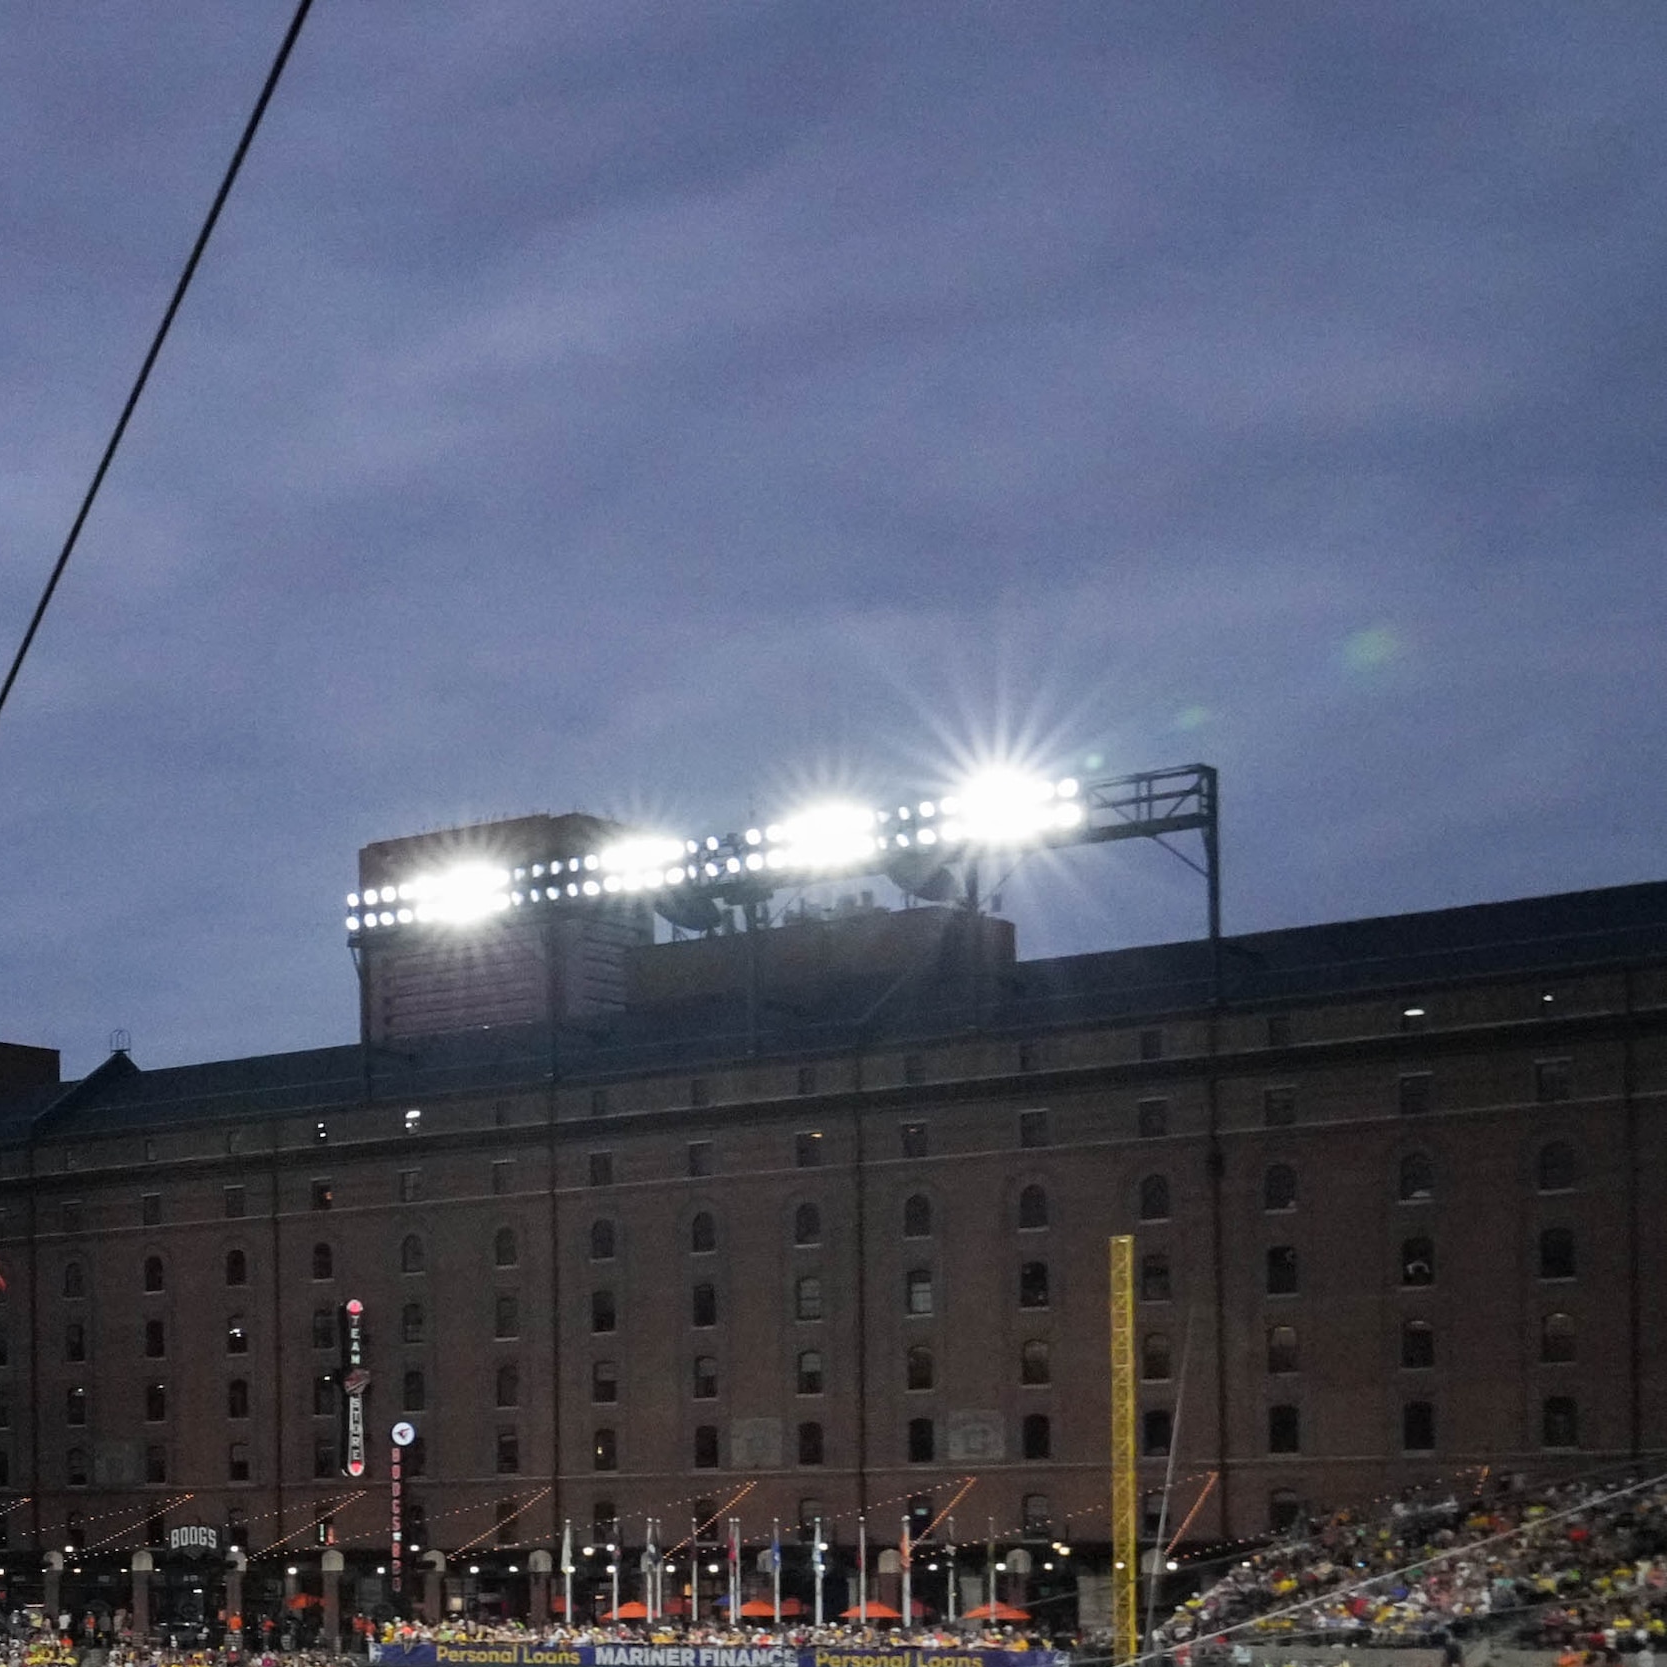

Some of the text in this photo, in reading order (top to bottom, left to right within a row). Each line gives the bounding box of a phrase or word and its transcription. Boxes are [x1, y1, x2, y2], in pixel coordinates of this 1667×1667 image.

[350, 1315, 361, 1365] TEAM
[170, 1526, 217, 1549] BOOGS
[436, 1646, 581, 1665] Personal Loans
[595, 1648, 694, 1667] MARINER
